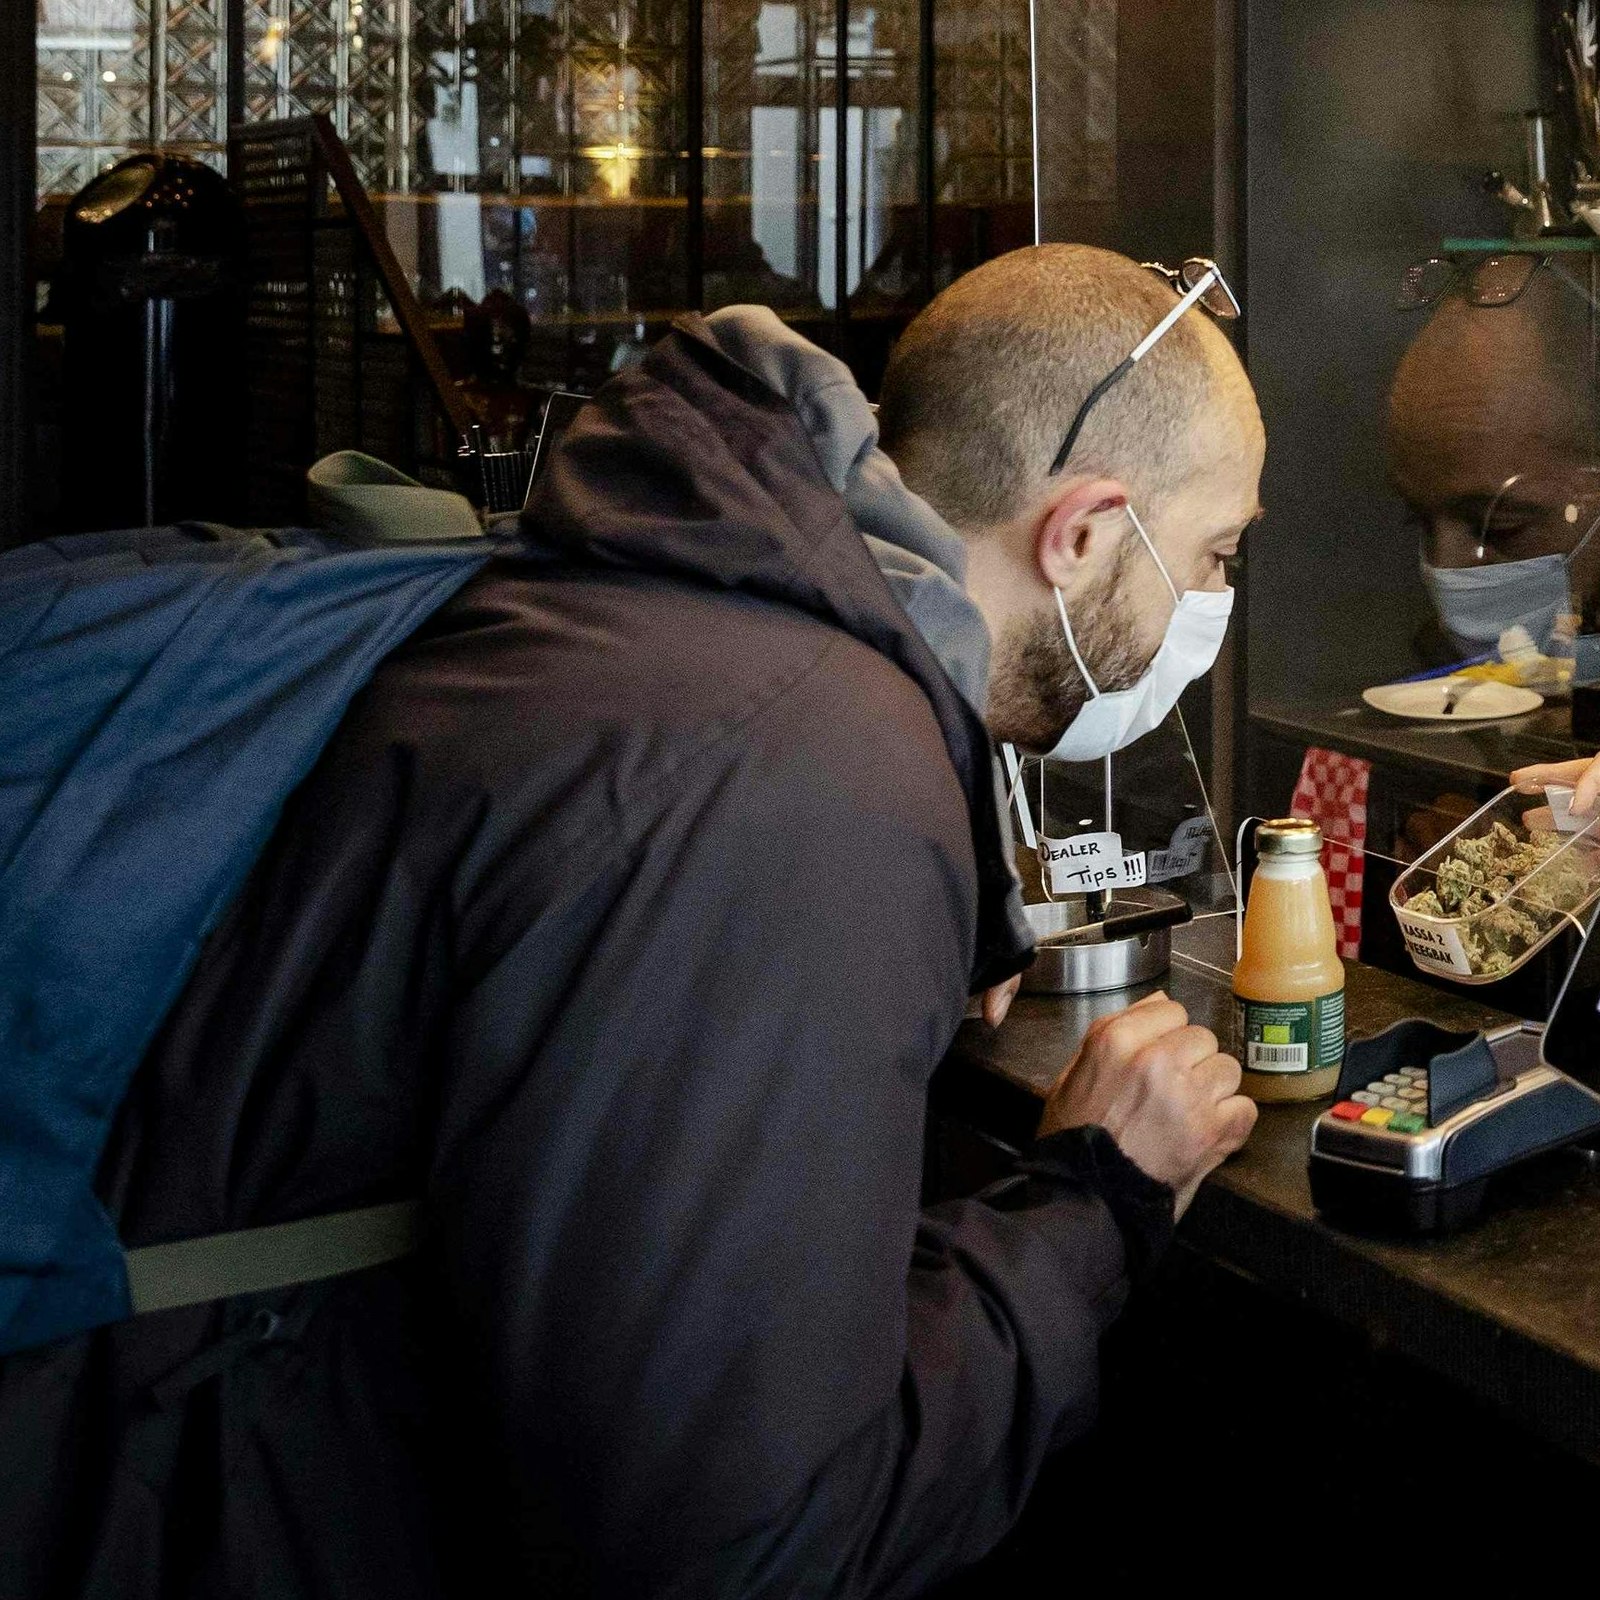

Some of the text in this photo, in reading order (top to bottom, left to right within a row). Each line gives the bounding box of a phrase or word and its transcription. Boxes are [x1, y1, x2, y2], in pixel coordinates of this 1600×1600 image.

[1041, 842, 1100, 861] DEALER
[1067, 866, 1117, 886] Tips
[1436, 934, 1445, 946] 2
